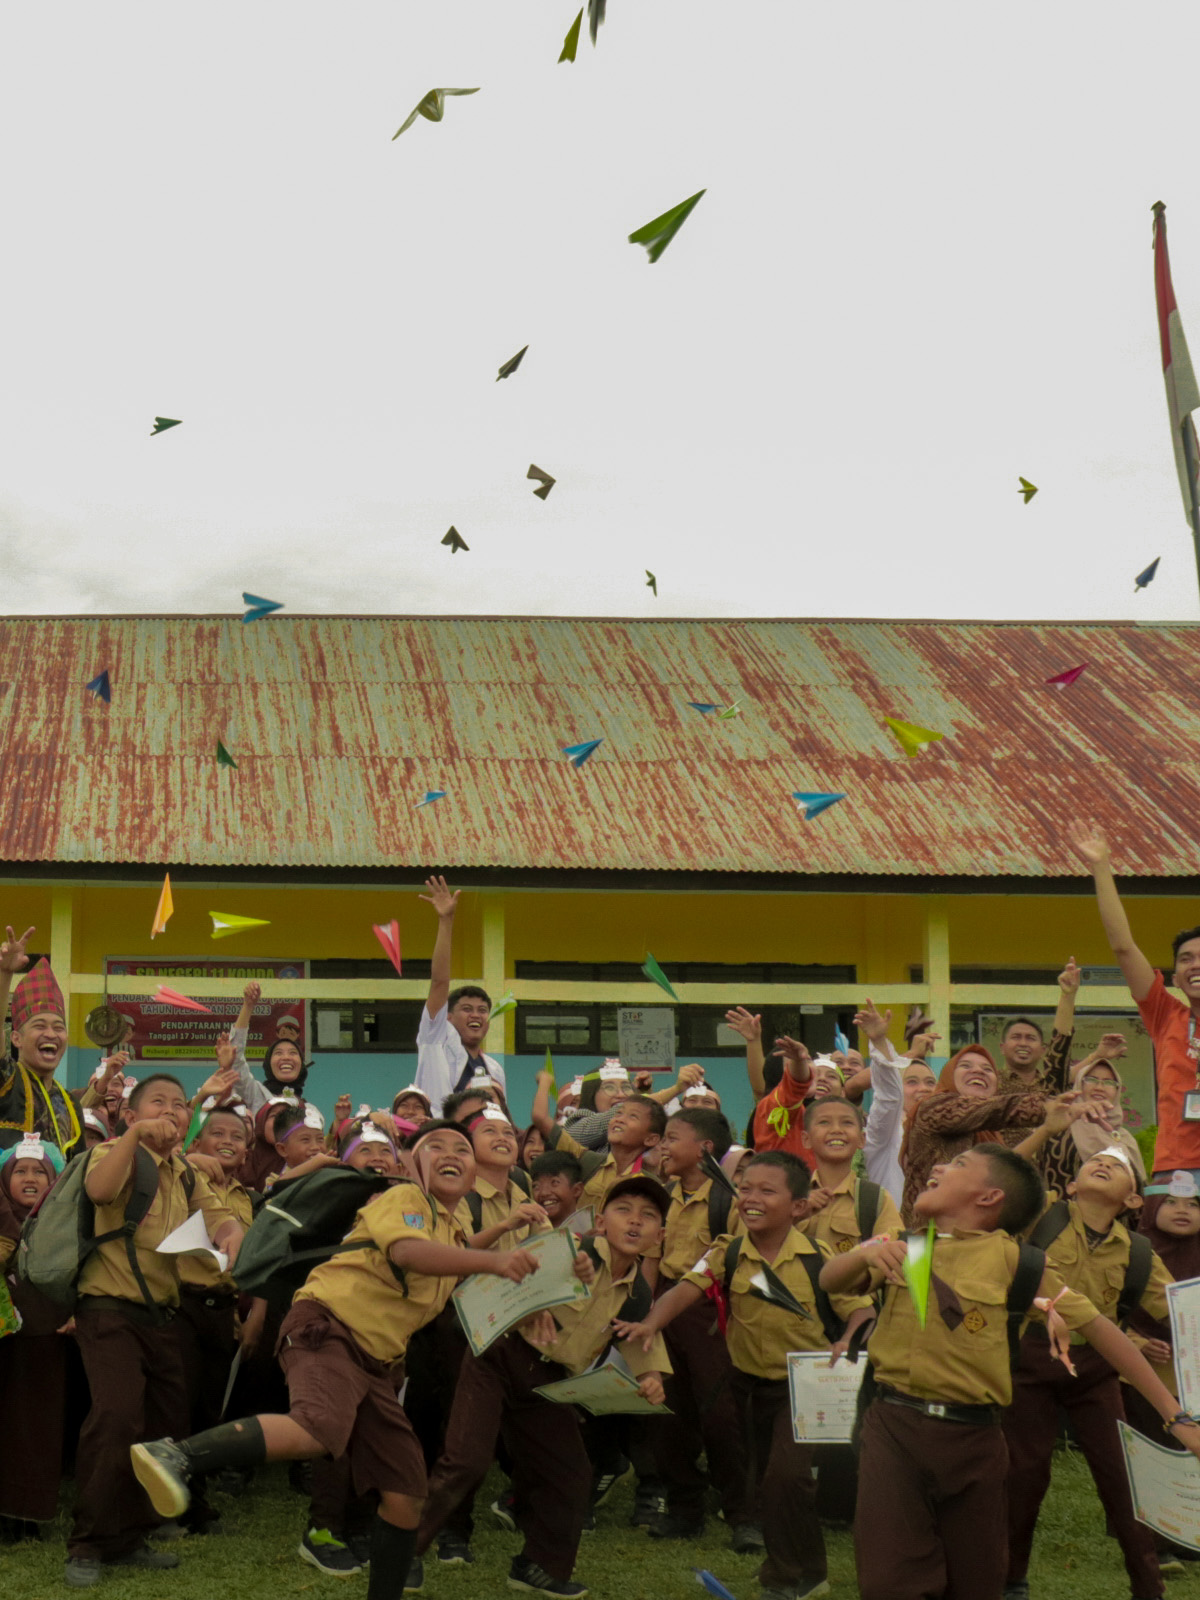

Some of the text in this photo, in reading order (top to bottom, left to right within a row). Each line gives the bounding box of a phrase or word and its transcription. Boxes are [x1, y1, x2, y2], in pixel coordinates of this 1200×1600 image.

[140, 1004, 173, 1014] TAHUN
[622, 1011, 643, 1020] STOP
[161, 1022, 221, 1030] PENDAFTARAN
[149, 1032, 178, 1041] Tanggal
[191, 1032, 207, 1040] Juni
